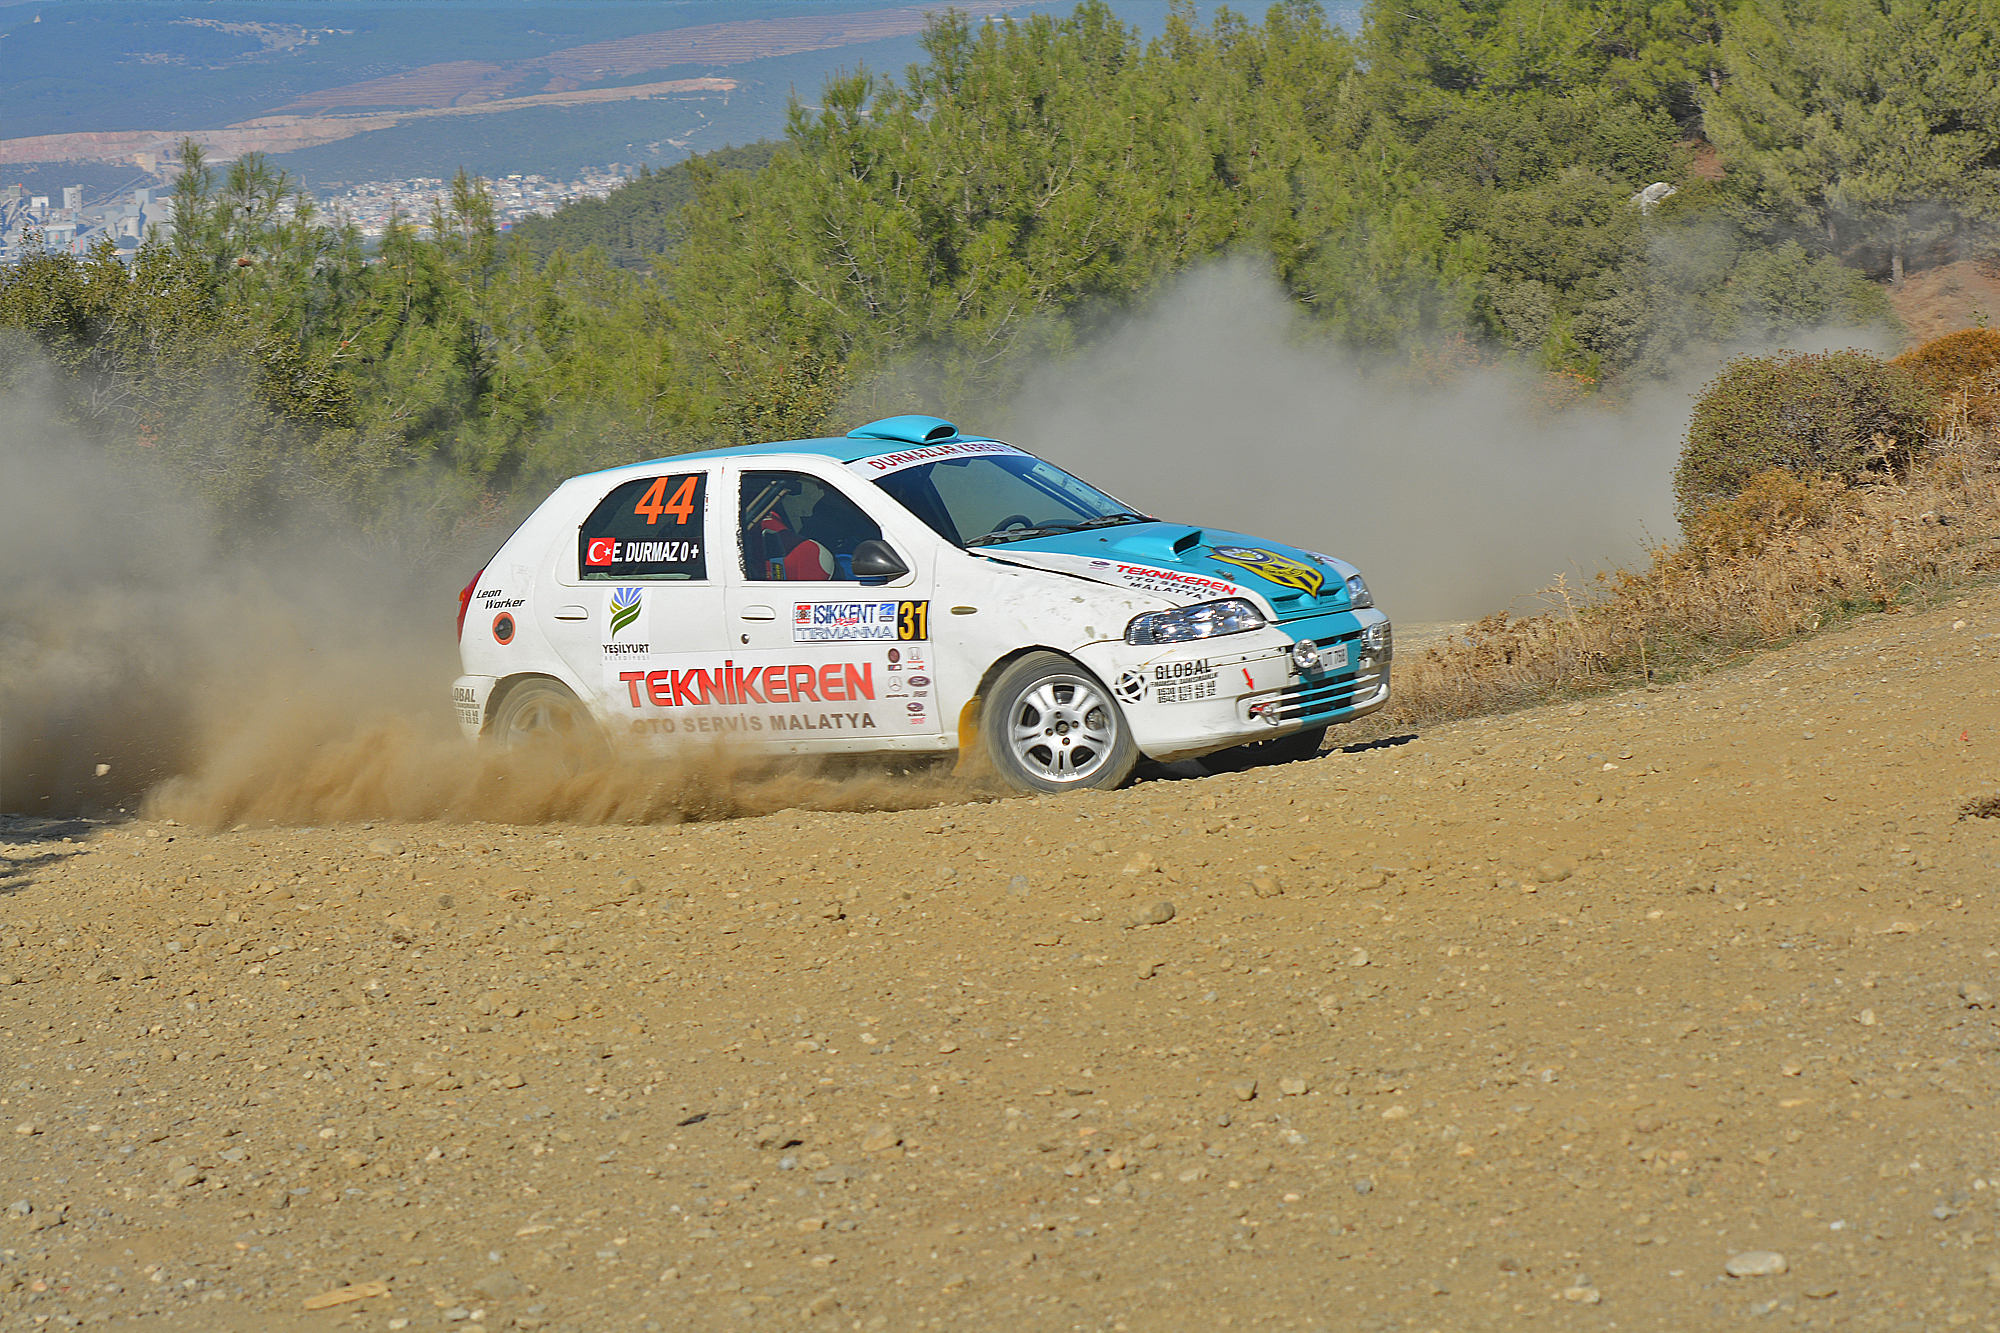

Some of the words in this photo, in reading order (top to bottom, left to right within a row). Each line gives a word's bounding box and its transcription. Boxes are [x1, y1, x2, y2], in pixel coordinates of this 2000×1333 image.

[867, 445, 958, 470] DURMAZLAR
[634, 476, 698, 525] 44
[611, 542, 623, 562] E.
[625, 542, 680, 562] DURMAZ
[1123, 575, 1154, 583] OTO
[476, 590, 502, 599] Leon
[1129, 582, 1203, 600] MALATYA
[484, 599, 525, 609] Worker
[898, 601, 928, 640] 31
[1155, 658, 1211, 680] GLOBAL
[619, 659, 876, 708] TEKNİKEREN
[769, 712, 877, 731] MALATYA
